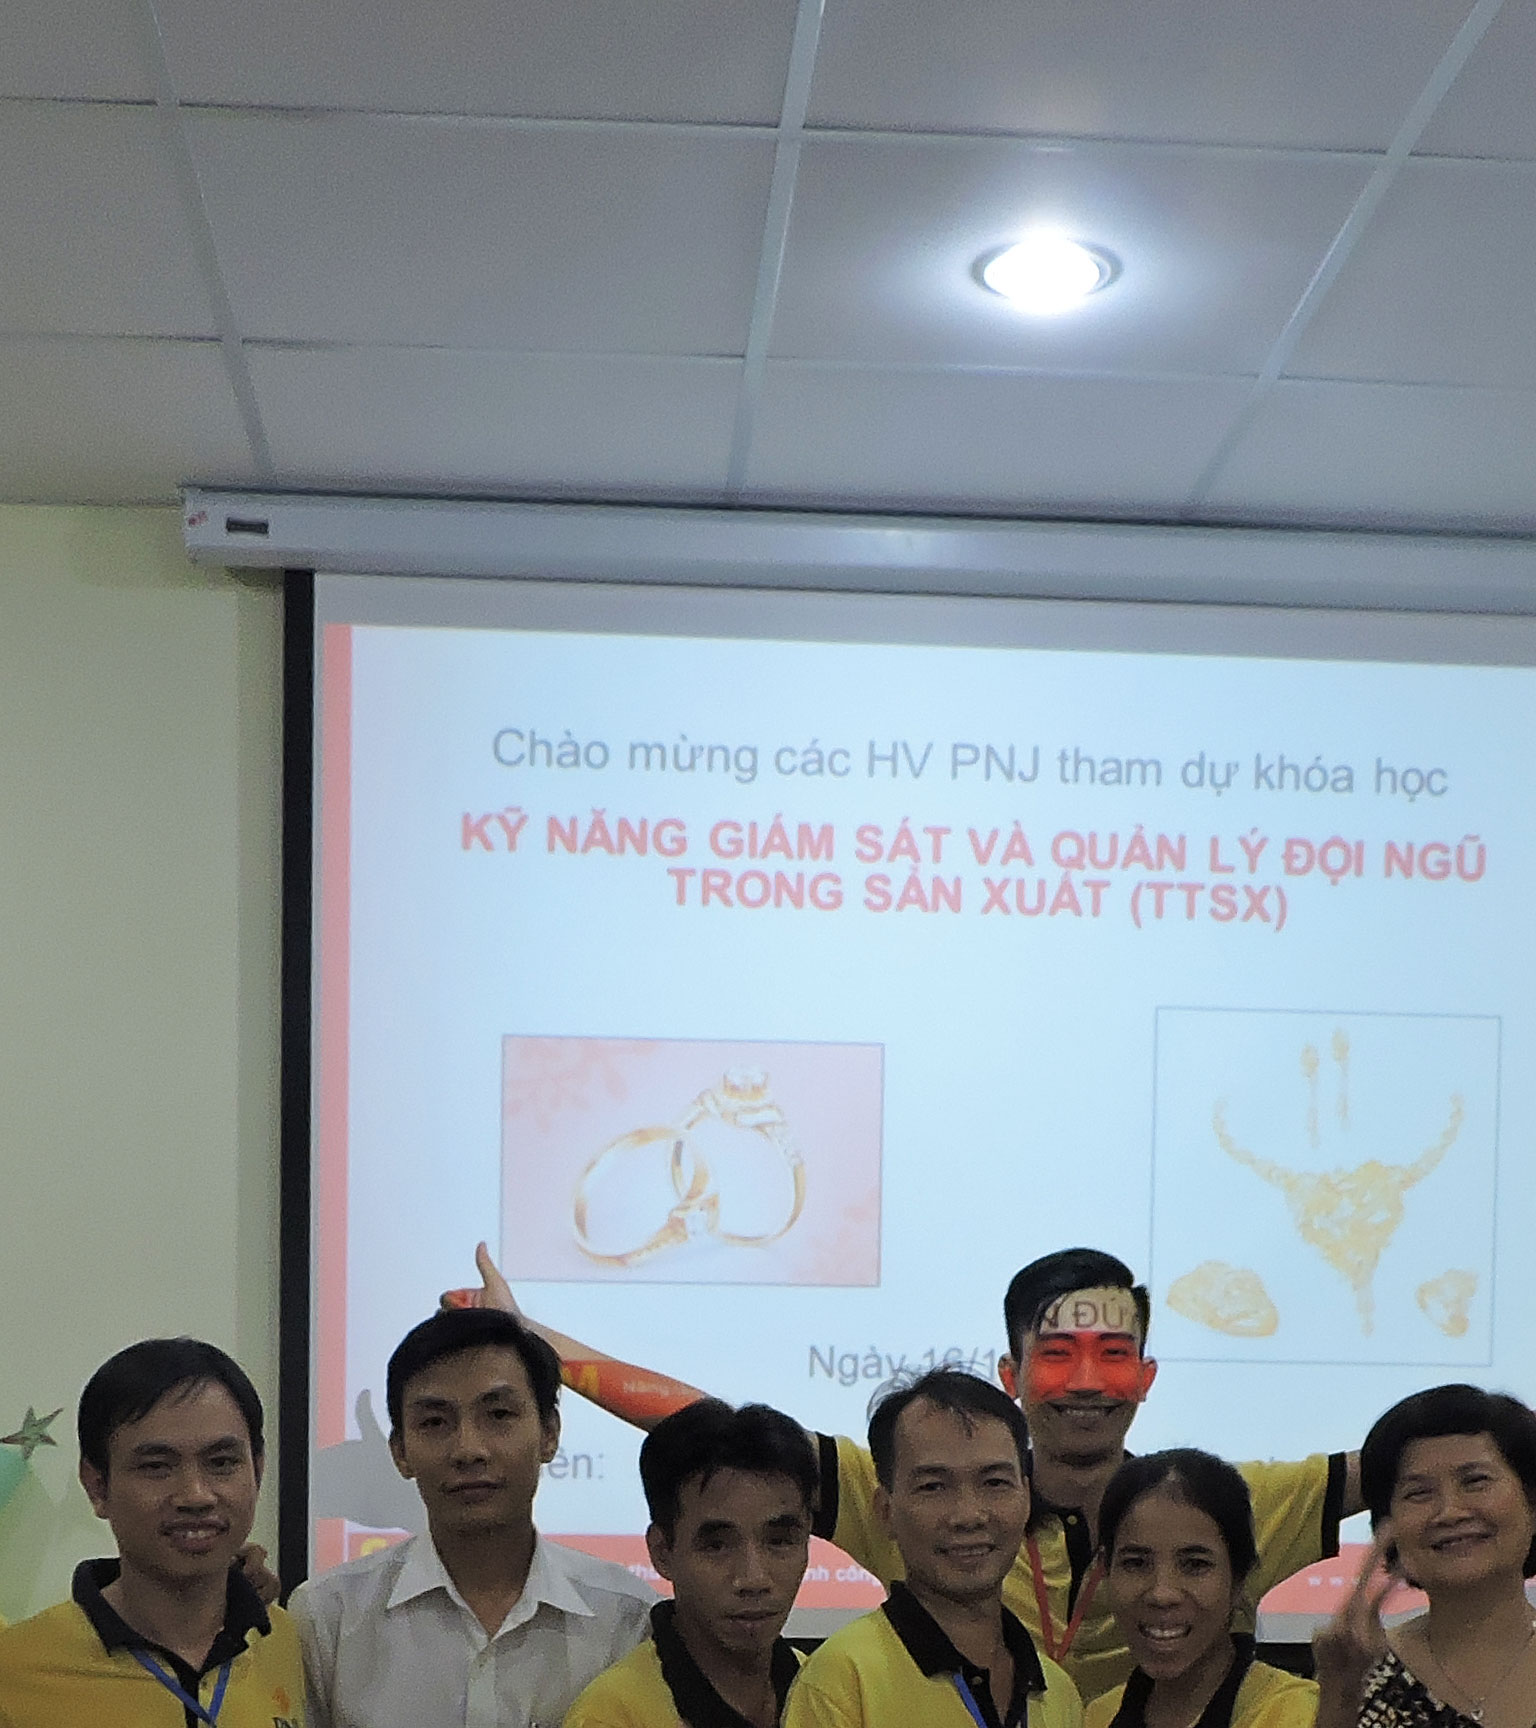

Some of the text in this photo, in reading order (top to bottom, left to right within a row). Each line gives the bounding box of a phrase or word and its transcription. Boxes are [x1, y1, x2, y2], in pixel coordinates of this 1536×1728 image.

[492, 728, 1450, 802] Chào mừng các HV PNJ tham dự khóa học
[461, 806, 529, 853] KỸ
[546, 808, 689, 858] NĂNG
[709, 814, 835, 863] GIÁM
[855, 817, 952, 865] SÁT
[967, 820, 1035, 868] VÀ
[1050, 824, 1187, 873] QUẢN
[1208, 828, 1269, 876] LÝ
[1383, 834, 1487, 884] NGŨ
[666, 868, 844, 912] TRONG
[862, 864, 962, 914] SẢN
[1131, 880, 1288, 933] (TTSX)
[808, 1345, 906, 1387] Ngày
[538, 1448, 604, 1480] ên:
